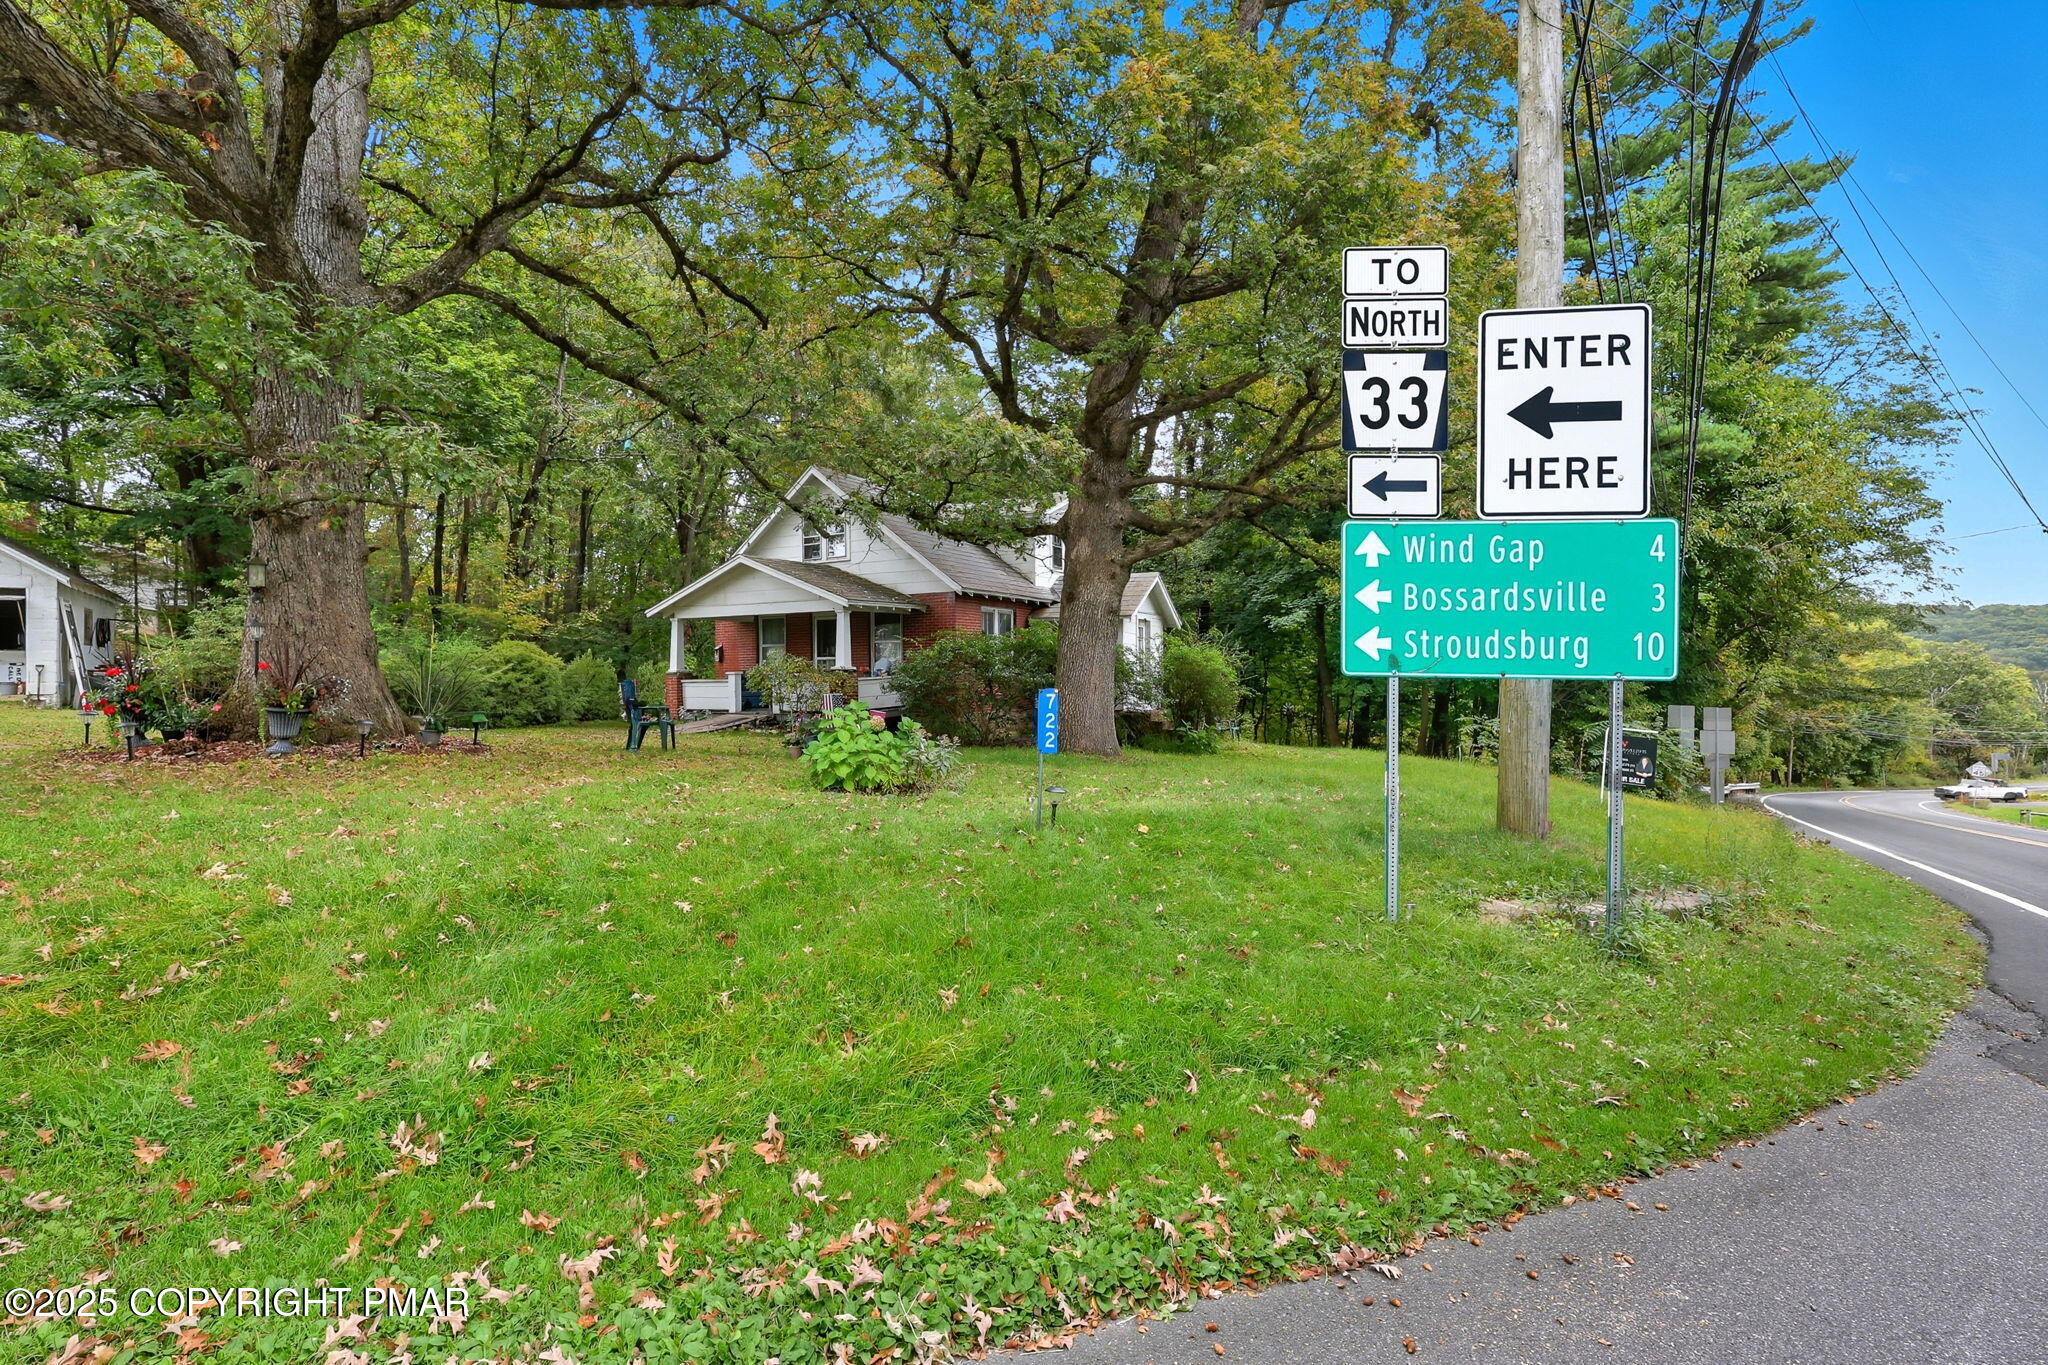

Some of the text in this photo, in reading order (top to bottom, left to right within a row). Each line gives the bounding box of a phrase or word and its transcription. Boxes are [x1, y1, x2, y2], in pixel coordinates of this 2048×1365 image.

[1372, 258, 1420, 285] TO
[1351, 306, 1440, 337] NORTH
[1497, 334, 1631, 370] ENTER
[1360, 376, 1428, 430] 33
[1508, 456, 1619, 490] HERE
[1403, 534, 1666, 571] Wind Gap 4
[1403, 581, 1665, 612] Bossardsville 3
[1403, 629, 1665, 668] Stroudsburg 10
[1045, 693, 1056, 748] 722
